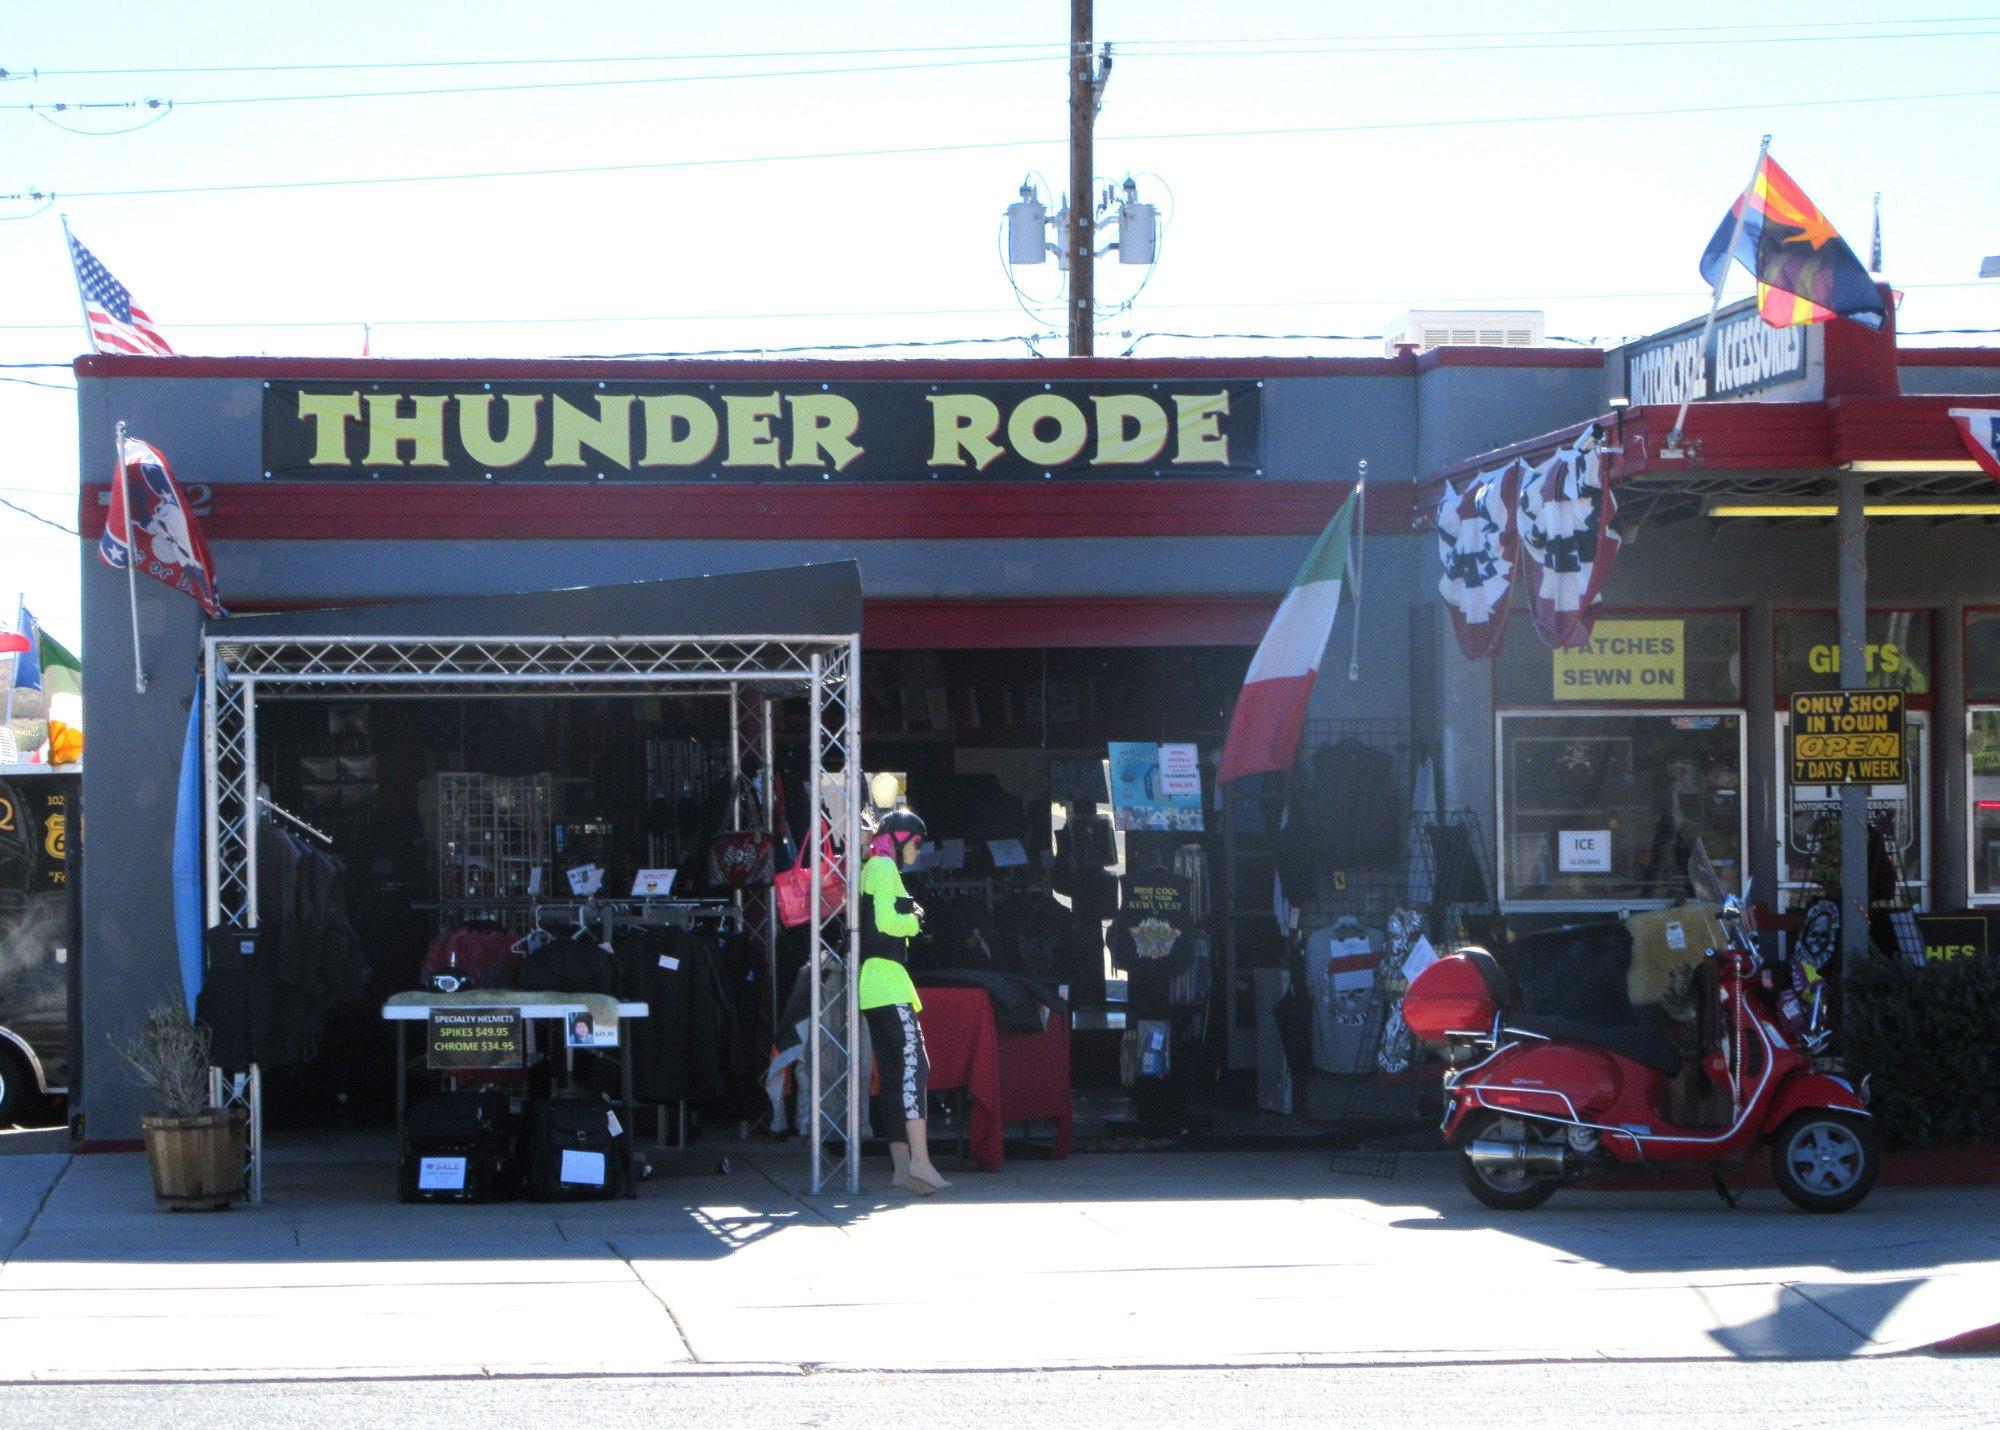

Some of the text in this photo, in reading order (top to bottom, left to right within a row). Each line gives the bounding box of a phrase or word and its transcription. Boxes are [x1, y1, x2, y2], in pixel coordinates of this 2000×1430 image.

[1631, 314, 1799, 406] MOTORCYCLE ACCESSORIES
[298, 388, 1230, 473] THUNDER RODE
[1808, 643, 1901, 674] GITS
[1562, 668, 1675, 685] SEWN ON
[1796, 694, 1899, 714] ONLY SHOP
[1807, 714, 1888, 732] IN TOWN
[1799, 735, 1896, 757] OPEN
[1796, 760, 1899, 778] 7 DAYS A WEEK
[1574, 838, 1595, 851] ICE
[434, 1015, 515, 1024] SPECIALTY HELMETS
[440, 1027, 509, 1037] SPIKES $49.95
[434, 1041, 515, 1052] CHROME $34.95
